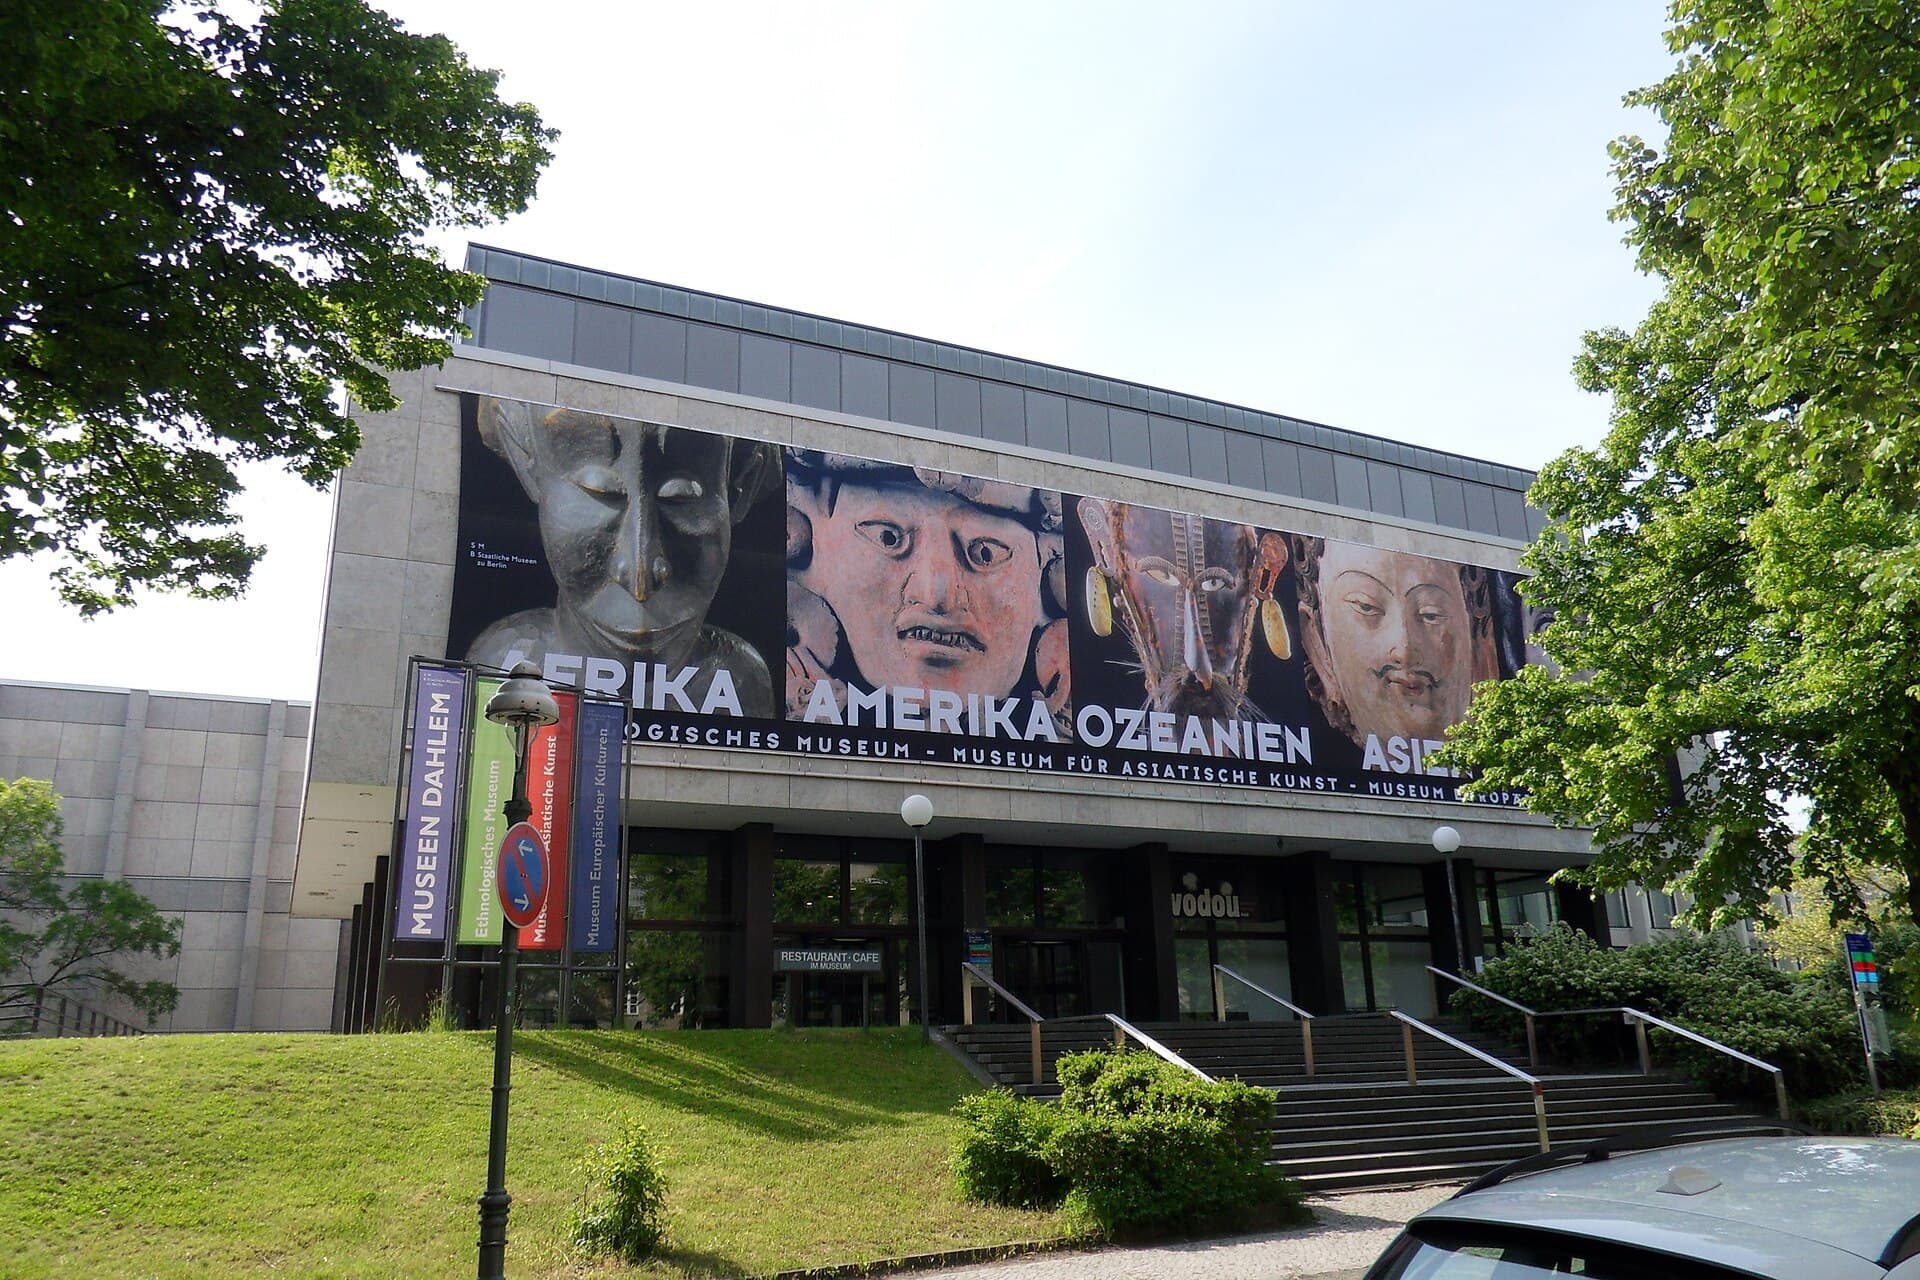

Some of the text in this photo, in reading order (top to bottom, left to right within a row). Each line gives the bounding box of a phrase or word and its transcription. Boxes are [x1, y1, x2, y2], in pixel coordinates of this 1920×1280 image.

[477, 552, 510, 561] Staatliche
[511, 555, 537, 565] Museen
[486, 560, 507, 569] Berlin
[501, 650, 1474, 779] FRIKA AMERIKA OZEANIEN ASIE
[422, 693, 451, 807] DAHLEM
[543, 735, 557, 776] Kunst
[595, 729, 608, 788] Kulturen
[797, 735, 909, 758] MUSEUM
[953, 747, 1053, 769] MUSEUM
[1067, 754, 1108, 774] FÜR
[1121, 760, 1257, 785] ASIATISCHE
[1270, 772, 1338, 792] KUNST
[1368, 780, 1445, 800] MUSEUM
[475, 760, 501, 937] Ethnologisches Museum
[591, 790, 606, 881] Europäischer
[411, 815, 441, 935] MUSEEN
[1171, 888, 1240, 918] vodou
[587, 883, 600, 946] Museum
[781, 951, 848, 962] RESTAURANT
[852, 952, 879, 963] CAFE
[819, 962, 851, 970] MUSEUM
